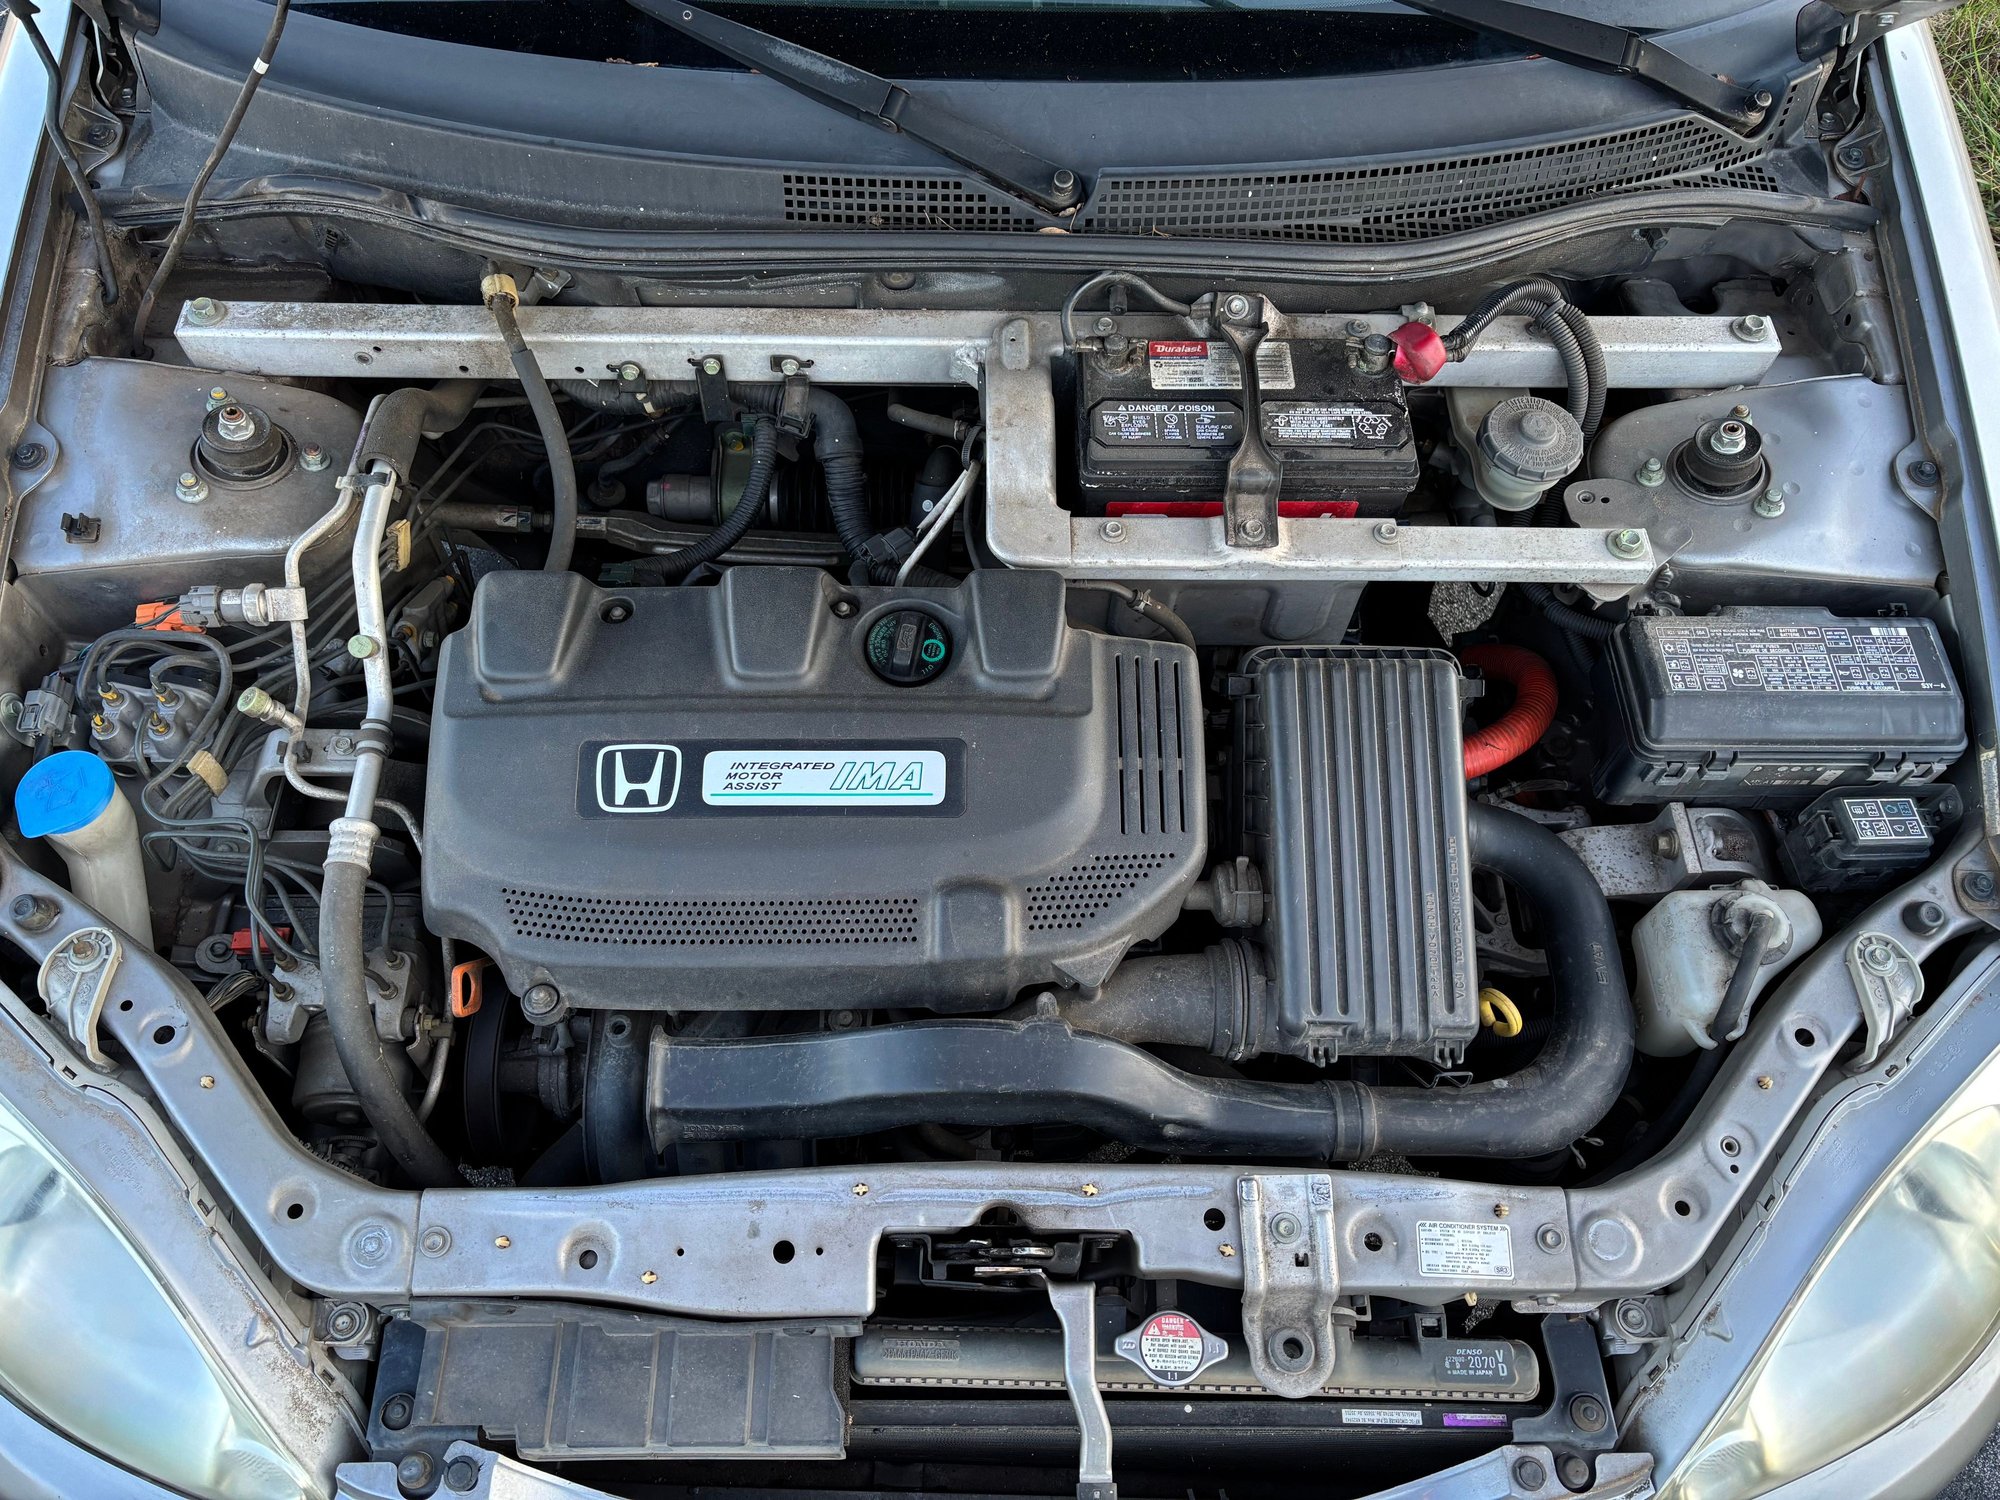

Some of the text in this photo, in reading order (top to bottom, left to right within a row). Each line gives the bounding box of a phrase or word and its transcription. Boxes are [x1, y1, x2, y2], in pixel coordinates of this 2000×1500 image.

[1155, 344, 1202, 353] Duralast
[1178, 404, 1215, 412] POISON
[729, 762, 835, 771] INTEGRATED
[725, 772, 783, 780] MOTOR
[829, 761, 924, 791] IMA
[722, 782, 783, 791] ASSIST
[1425, 894, 1436, 929] HONDA
[896, 1340, 945, 1348] HONDA
[1495, 1350, 1504, 1362] V
[1468, 1356, 1496, 1368] 2070
[1498, 1364, 1507, 1376] D
[1167, 1372, 1178, 1380] 1.1
